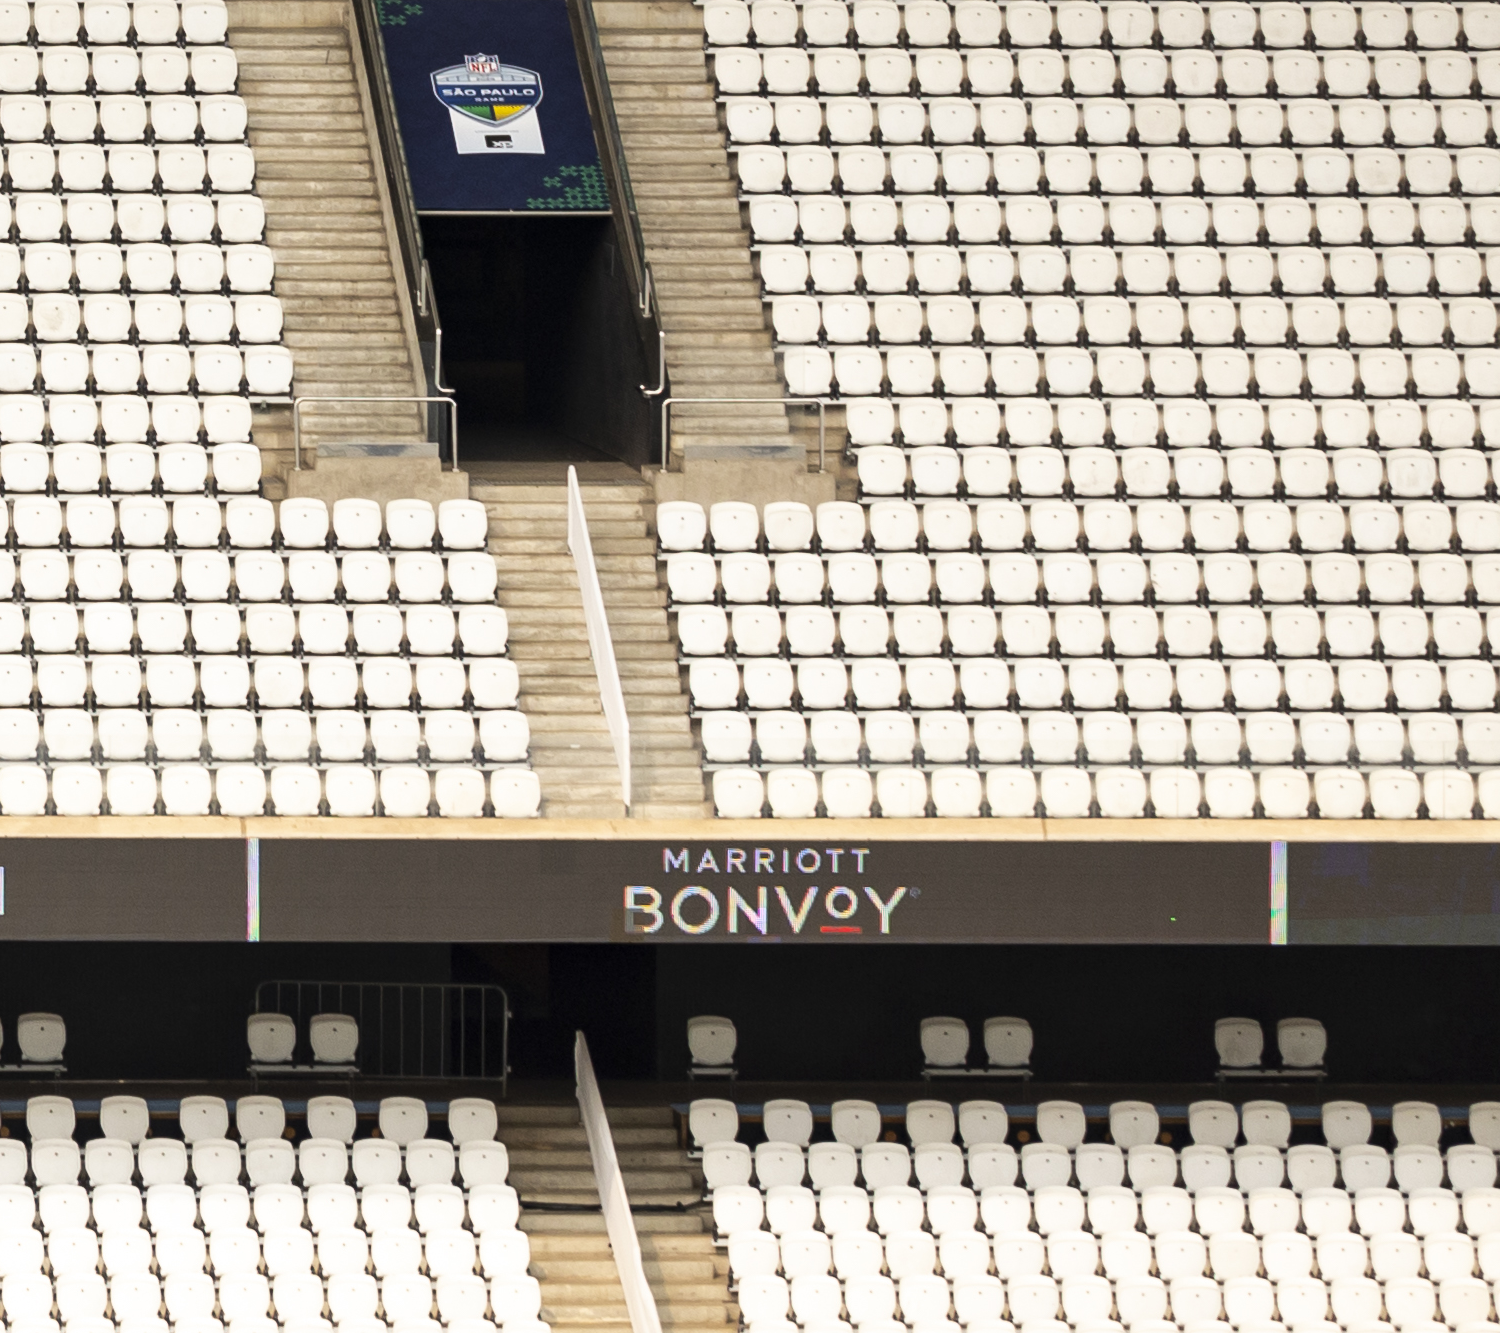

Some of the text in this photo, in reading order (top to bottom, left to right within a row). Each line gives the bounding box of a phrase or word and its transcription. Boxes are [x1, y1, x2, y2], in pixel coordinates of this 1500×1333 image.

[471, 63, 498, 73] NFL
[442, 87, 536, 97] SÃO PAULO
[662, 846, 873, 876] MARRIOTT
